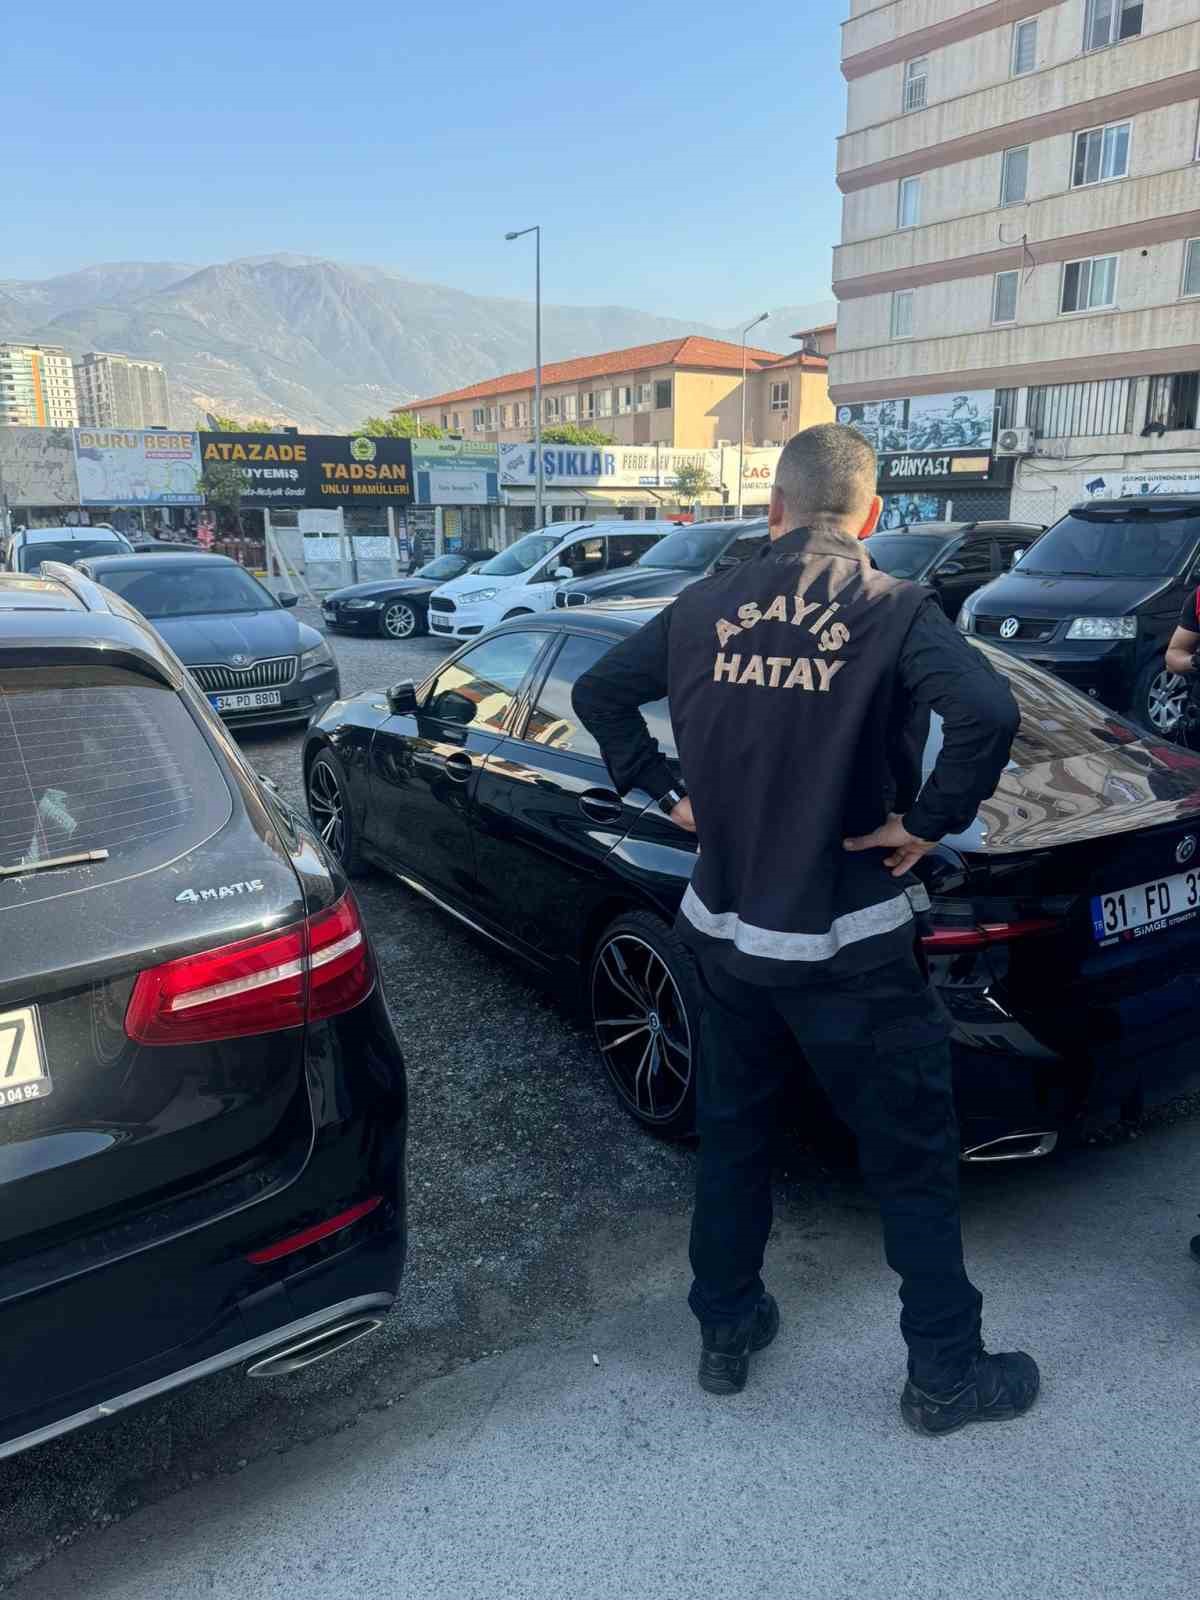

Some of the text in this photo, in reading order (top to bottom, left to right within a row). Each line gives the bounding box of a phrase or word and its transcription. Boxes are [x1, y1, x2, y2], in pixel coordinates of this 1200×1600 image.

[80, 433, 138, 449] DURU
[204, 443, 306, 461] ATAZADE
[321, 463, 406, 480] TADSAN
[889, 456, 950, 477] DÜNYASI
[321, 482, 409, 495] UNLU MAMÜLLERİ
[713, 652, 847, 691] HATAY
[218, 696, 231, 709] 34
[176, 879, 264, 904] 4MATIC
[1104, 873, 1200, 932] 31 FD 3
[7, 1088, 22, 1102] 04
[24, 1083, 40, 1098] 82
